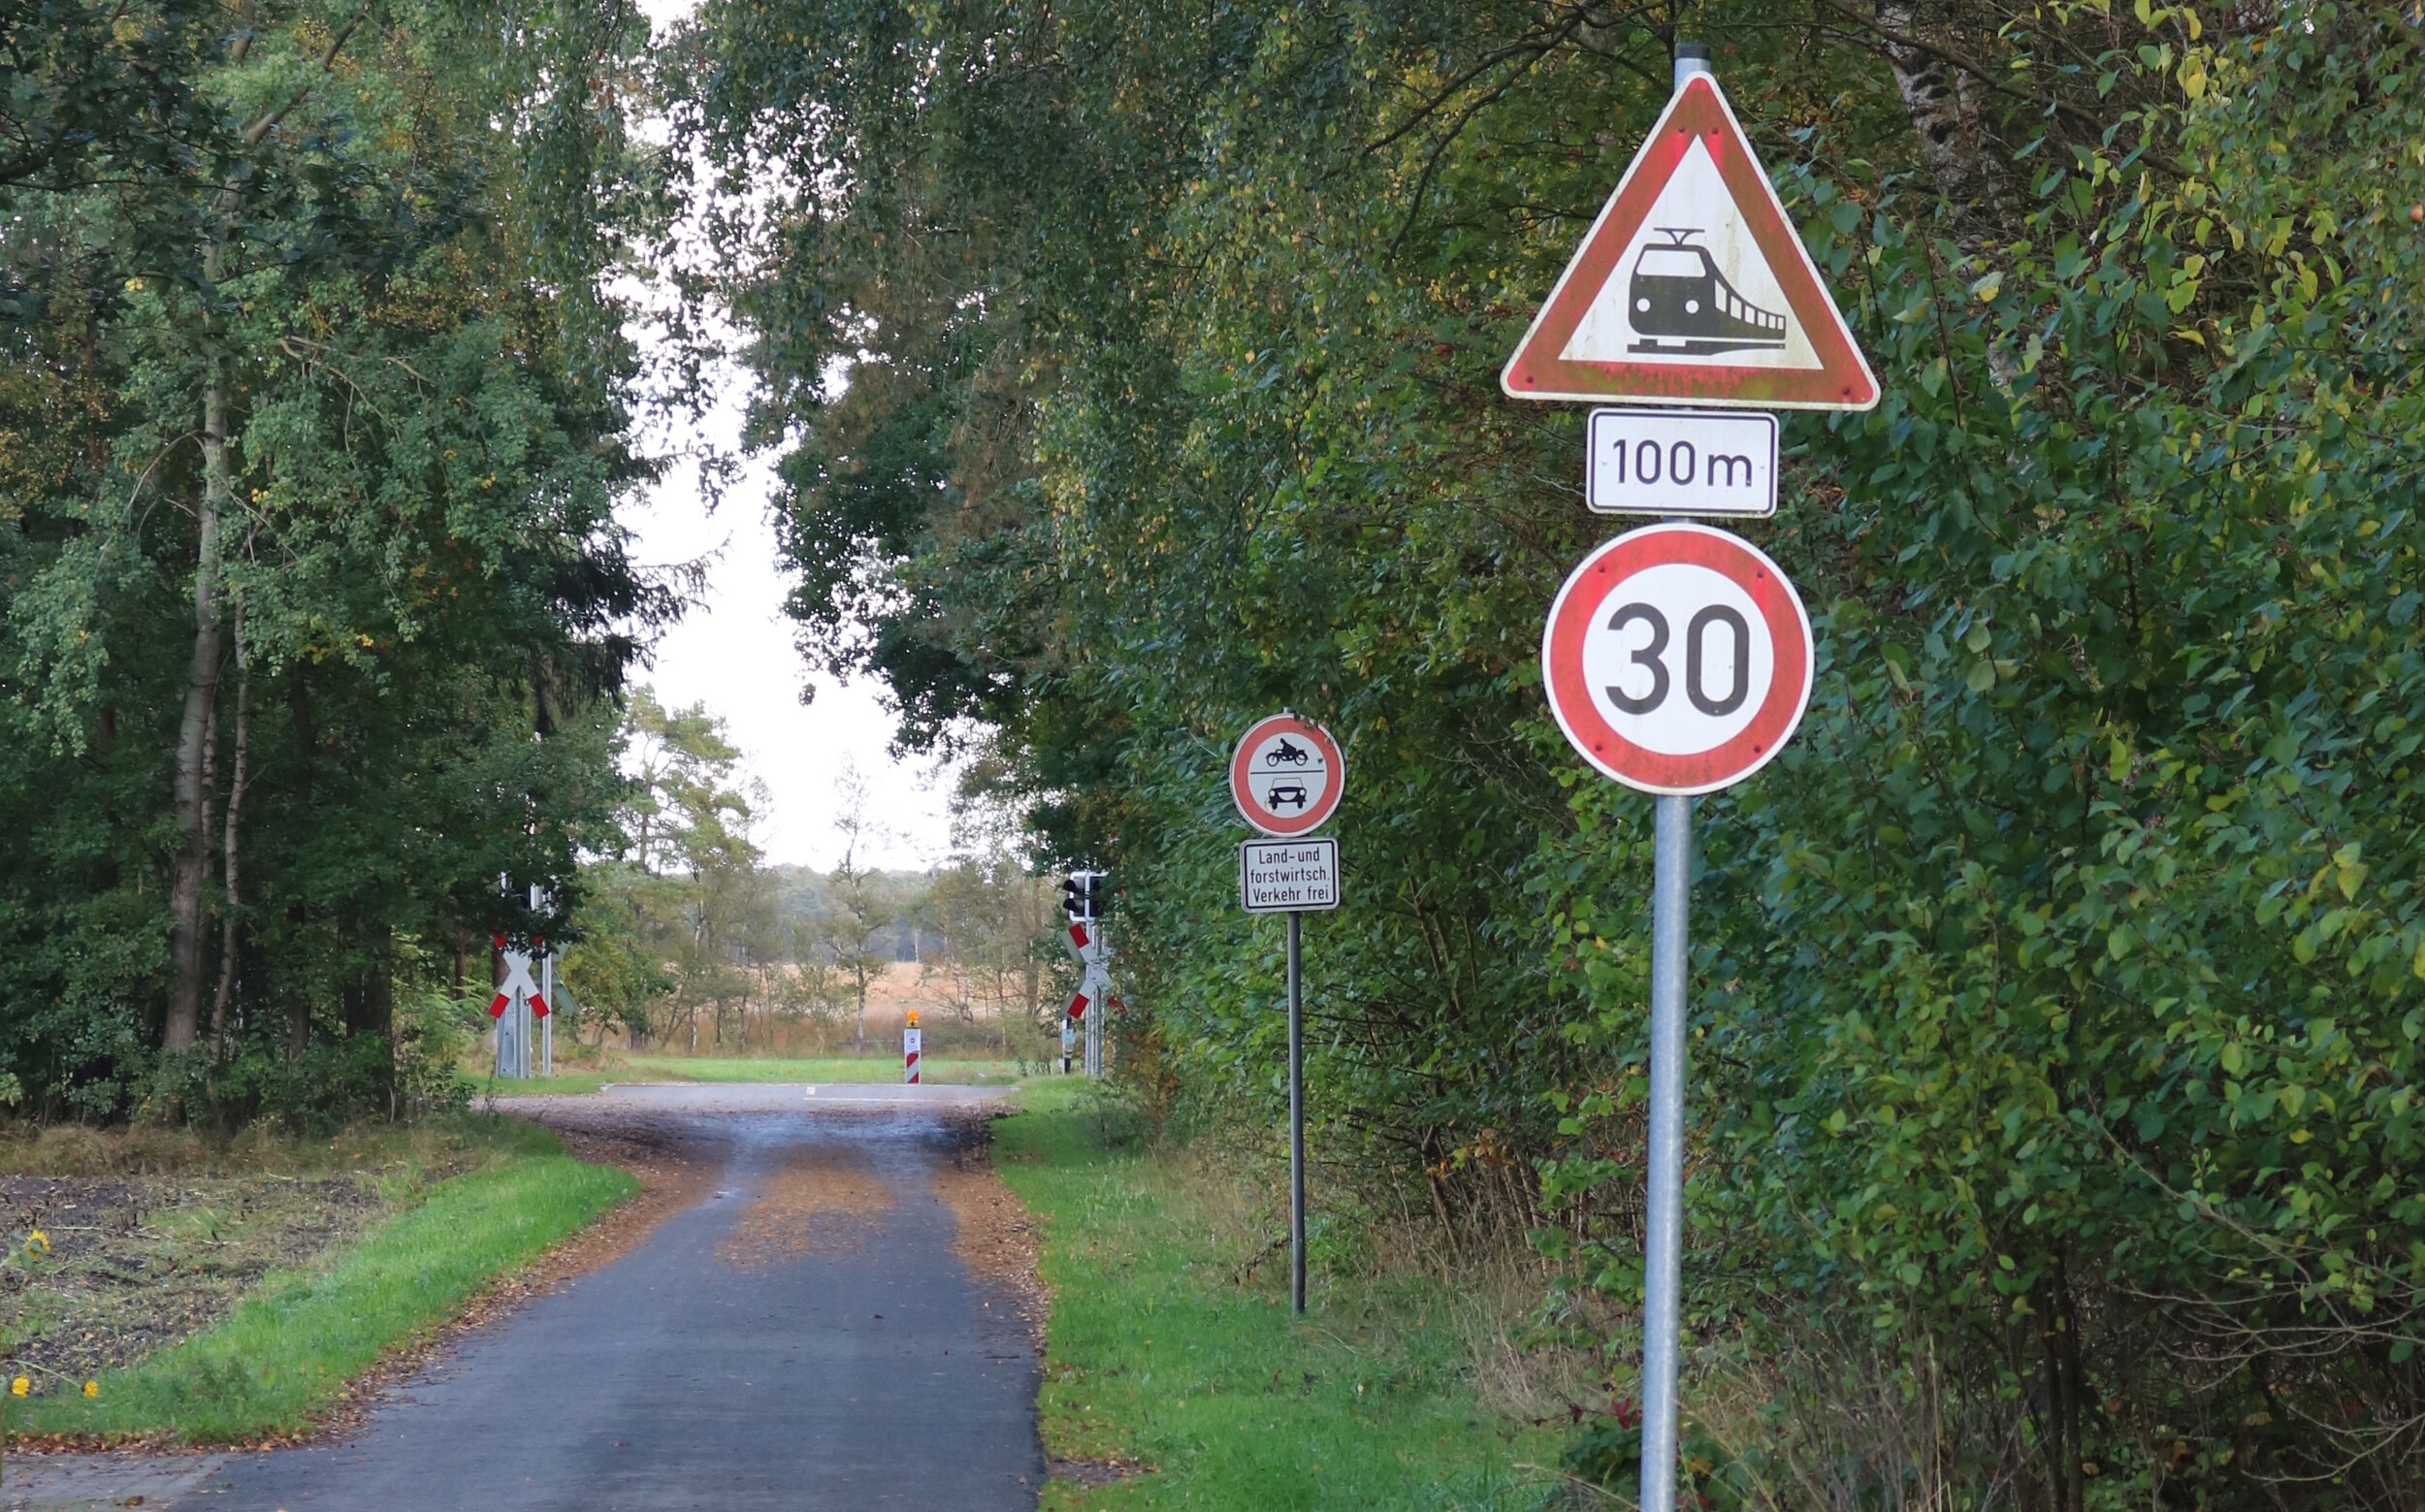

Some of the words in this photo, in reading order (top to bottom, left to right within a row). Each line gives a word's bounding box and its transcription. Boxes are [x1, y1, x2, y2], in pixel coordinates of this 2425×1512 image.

[1605, 601, 1750, 716] 30
[1250, 865, 1330, 884] forstwirtsch.
[1253, 886, 1301, 903] Verkehr
[1307, 885, 1329, 901] frei
